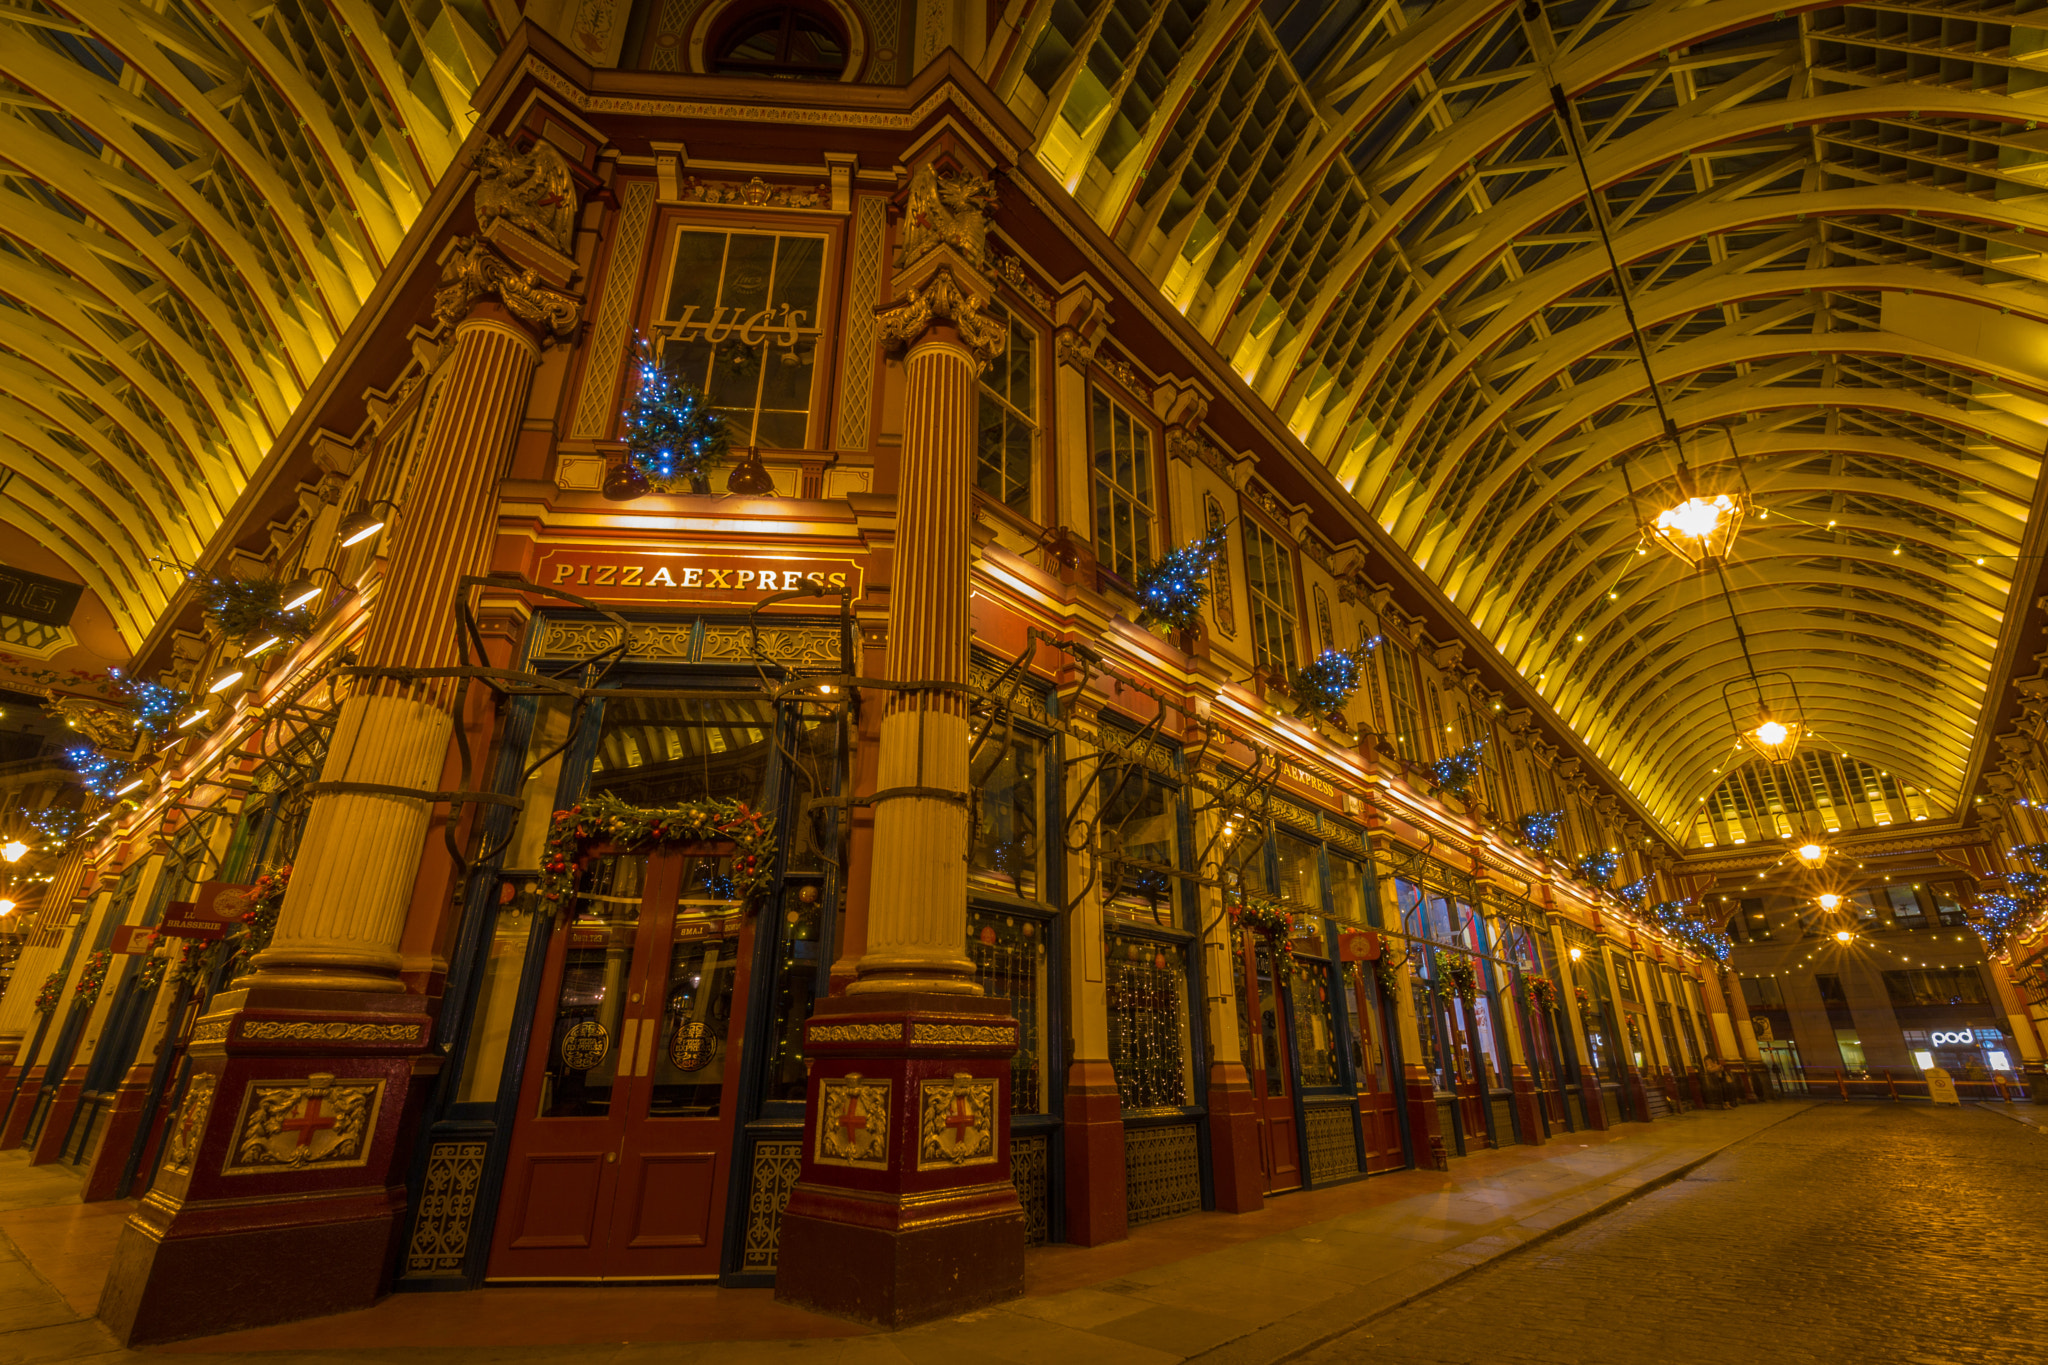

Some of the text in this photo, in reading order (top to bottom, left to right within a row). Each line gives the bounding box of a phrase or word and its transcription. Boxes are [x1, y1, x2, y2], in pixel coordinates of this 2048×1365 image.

[666, 303, 807, 347] LUC'S
[552, 563, 847, 591] PIZZAEXPRESS
[167, 920, 221, 930] BRASSERIE
[1931, 1028, 1974, 1047] pod
